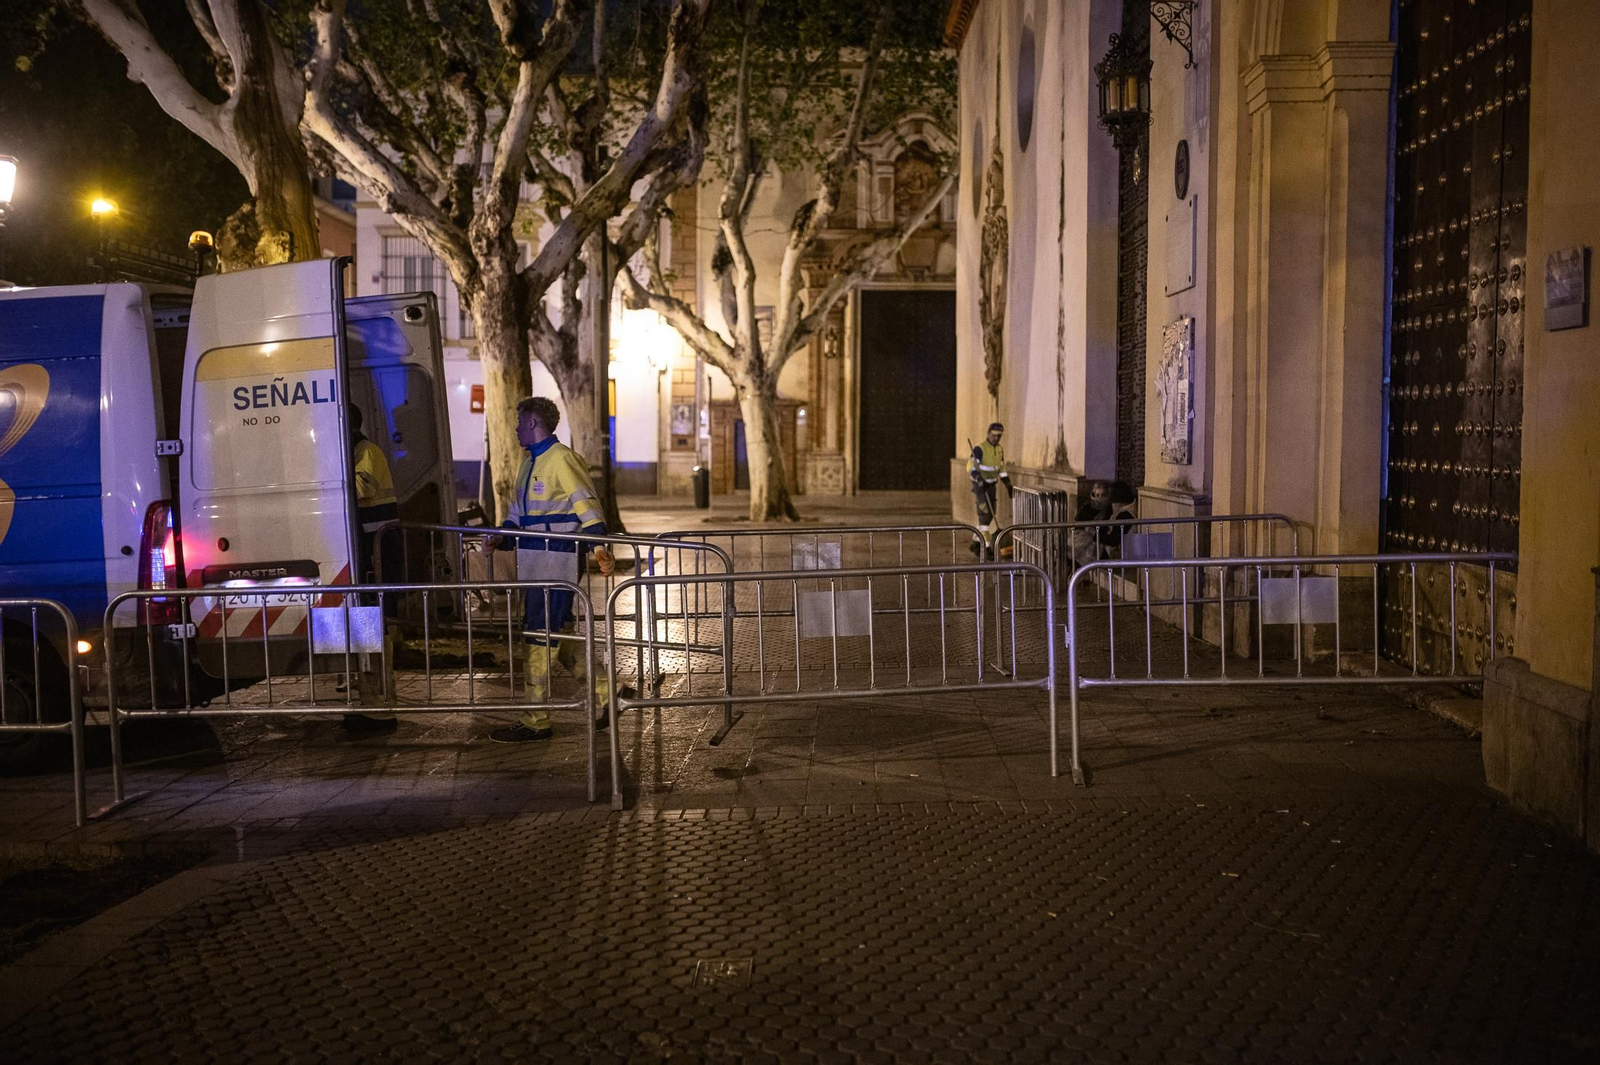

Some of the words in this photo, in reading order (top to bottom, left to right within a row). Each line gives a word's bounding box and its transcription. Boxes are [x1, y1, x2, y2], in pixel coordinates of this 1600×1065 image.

[233, 376, 336, 411] SEÑALI
[242, 417, 258, 426] NO
[265, 415, 281, 425] DO
[229, 567, 288, 578] MASTER
